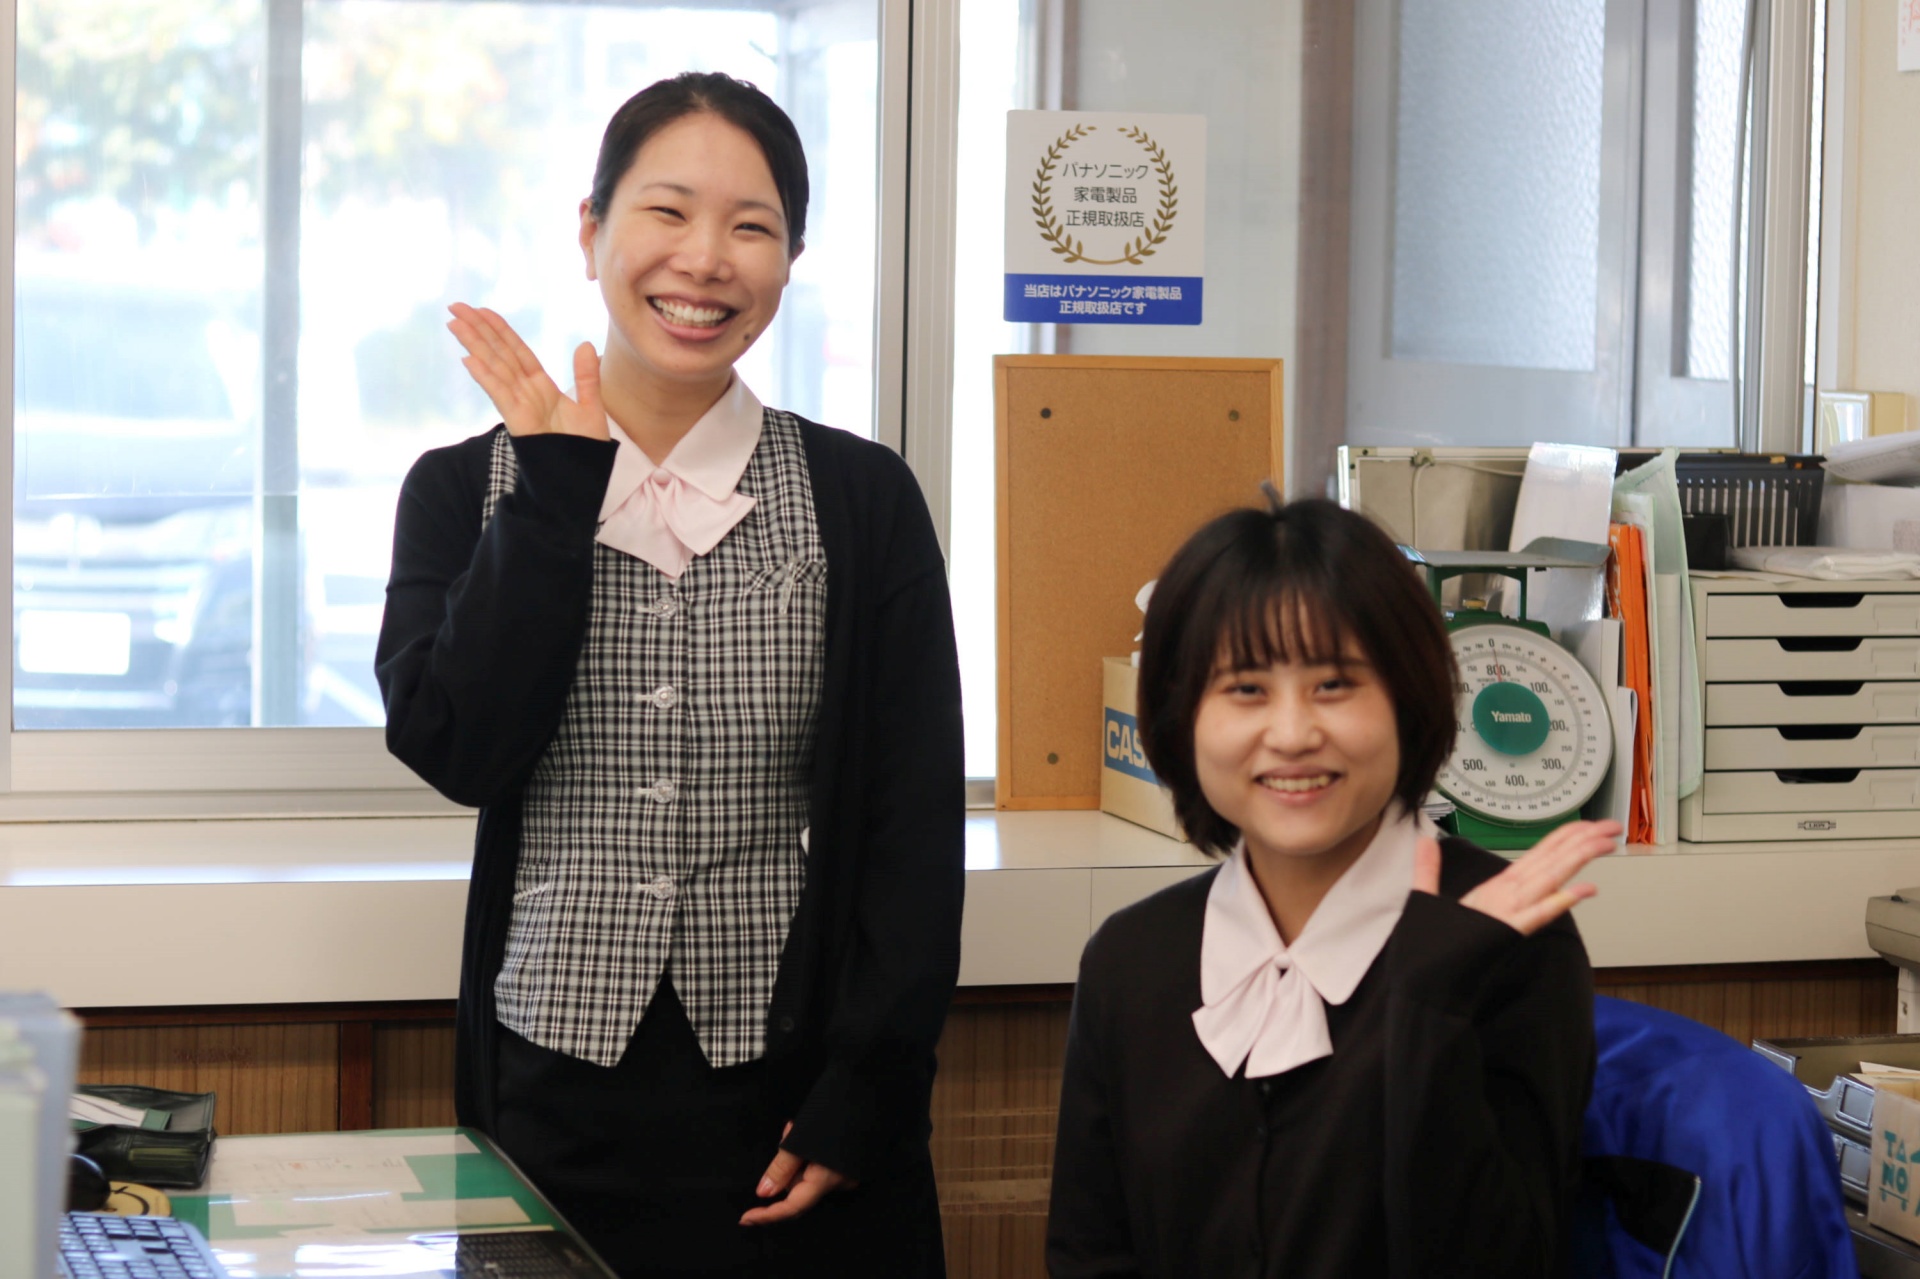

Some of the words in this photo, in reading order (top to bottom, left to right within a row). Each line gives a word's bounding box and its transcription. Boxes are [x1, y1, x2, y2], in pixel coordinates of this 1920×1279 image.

[1062, 162, 1149, 180] パナソニック
[1074, 186, 1138, 204] 家電製品
[1065, 209, 1145, 228] 正規取扱店
[1023, 283, 1183, 301] 当店はパナソニック家電製品
[1059, 300, 1147, 315] 正規取扱店です
[1488, 638, 1495, 648] 0
[1491, 710, 1532, 723] Yamato
[1106, 720, 1152, 770] CAS
[1882, 1161, 1908, 1194] NO
